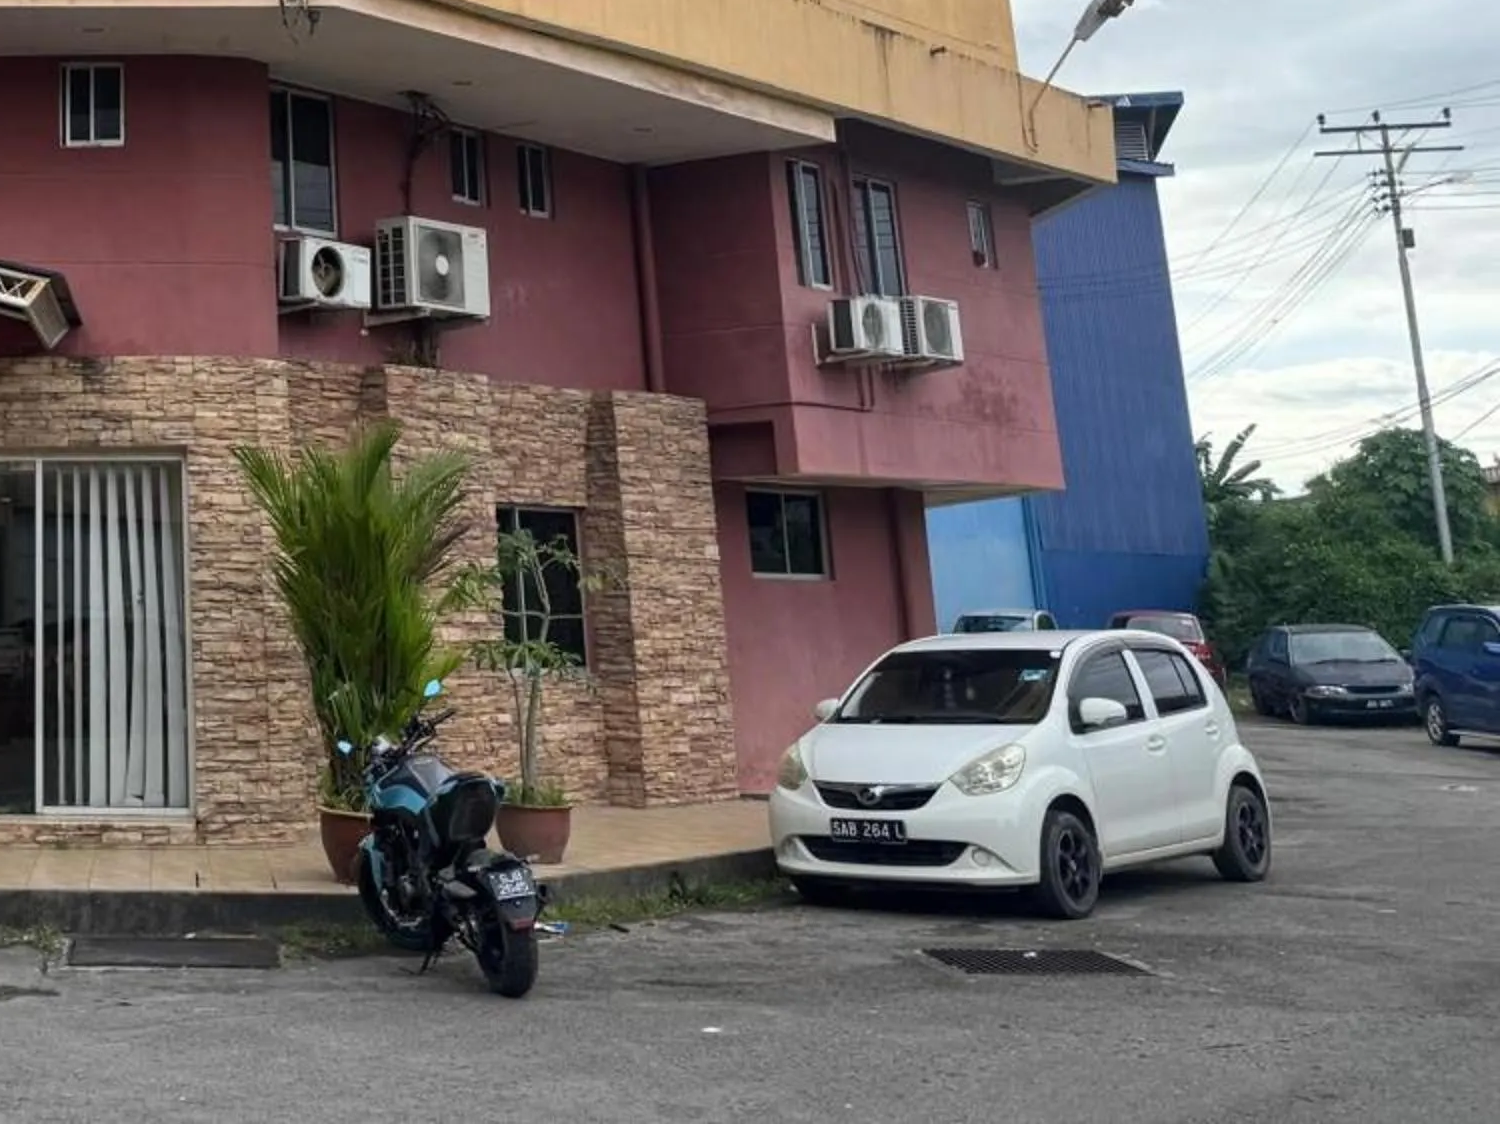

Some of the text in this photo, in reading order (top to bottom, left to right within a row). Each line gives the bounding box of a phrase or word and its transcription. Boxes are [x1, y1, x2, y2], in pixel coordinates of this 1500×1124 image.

[833, 821, 904, 840] SAB 264 L
